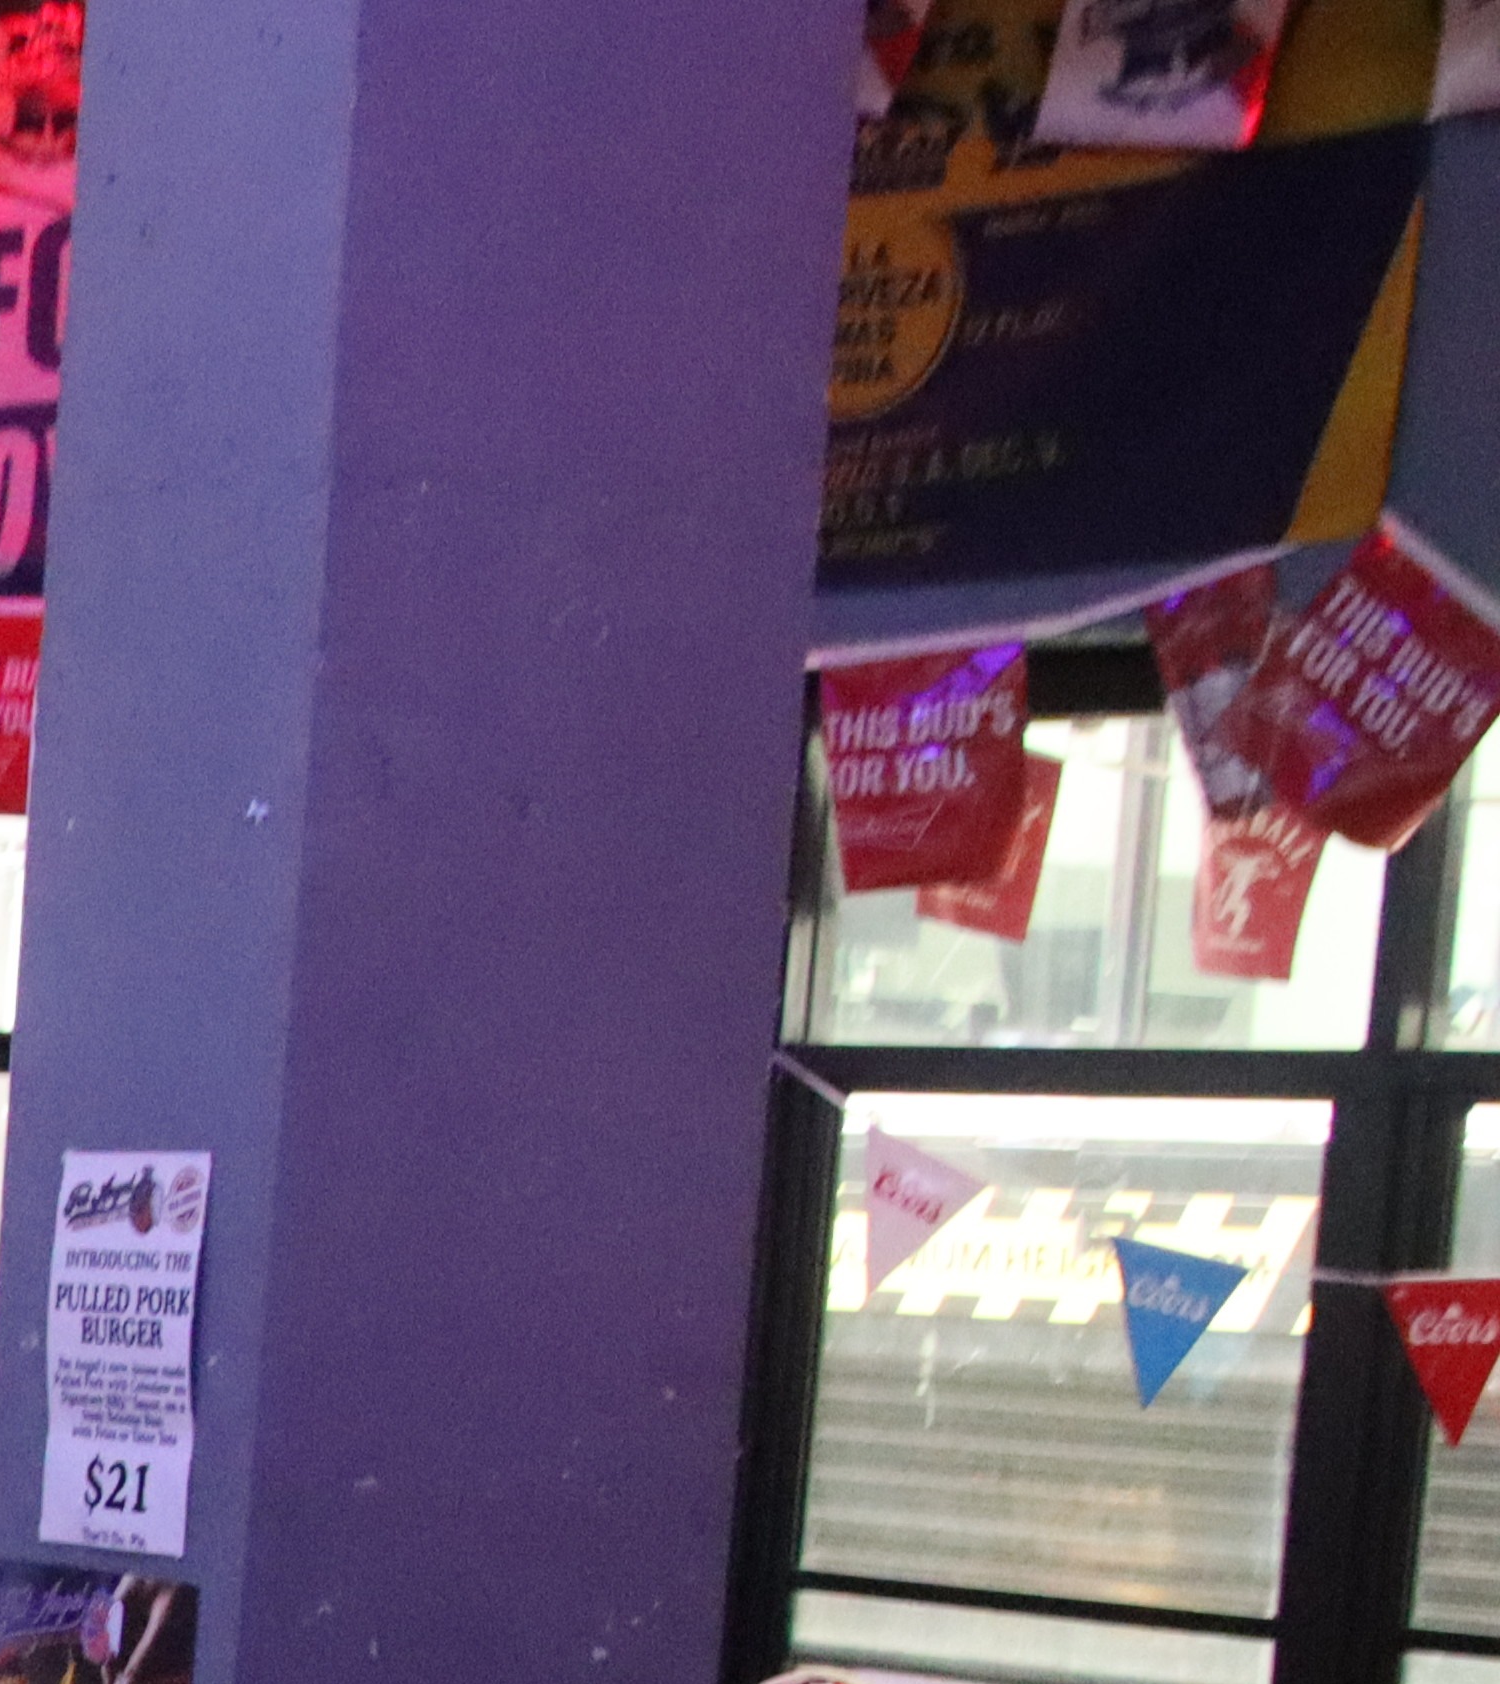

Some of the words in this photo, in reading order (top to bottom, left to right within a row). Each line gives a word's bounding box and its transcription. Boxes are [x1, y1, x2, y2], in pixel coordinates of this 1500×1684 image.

[1322, 575, 1383, 667] THIS
[1288, 620, 1349, 697] FOR
[827, 705, 898, 752] THIS
[905, 692, 1015, 746] BUD'S
[65, 1249, 160, 1271] INTRODUCING
[165, 1253, 193, 1272] THE
[55, 1283, 131, 1314] PULLED
[135, 1286, 191, 1317] PORK
[1127, 1274, 1207, 1324] Coors
[80, 1317, 164, 1349] BURGER
[1408, 1306, 1500, 1347] Coors
[83, 1451, 151, 1517] $21
